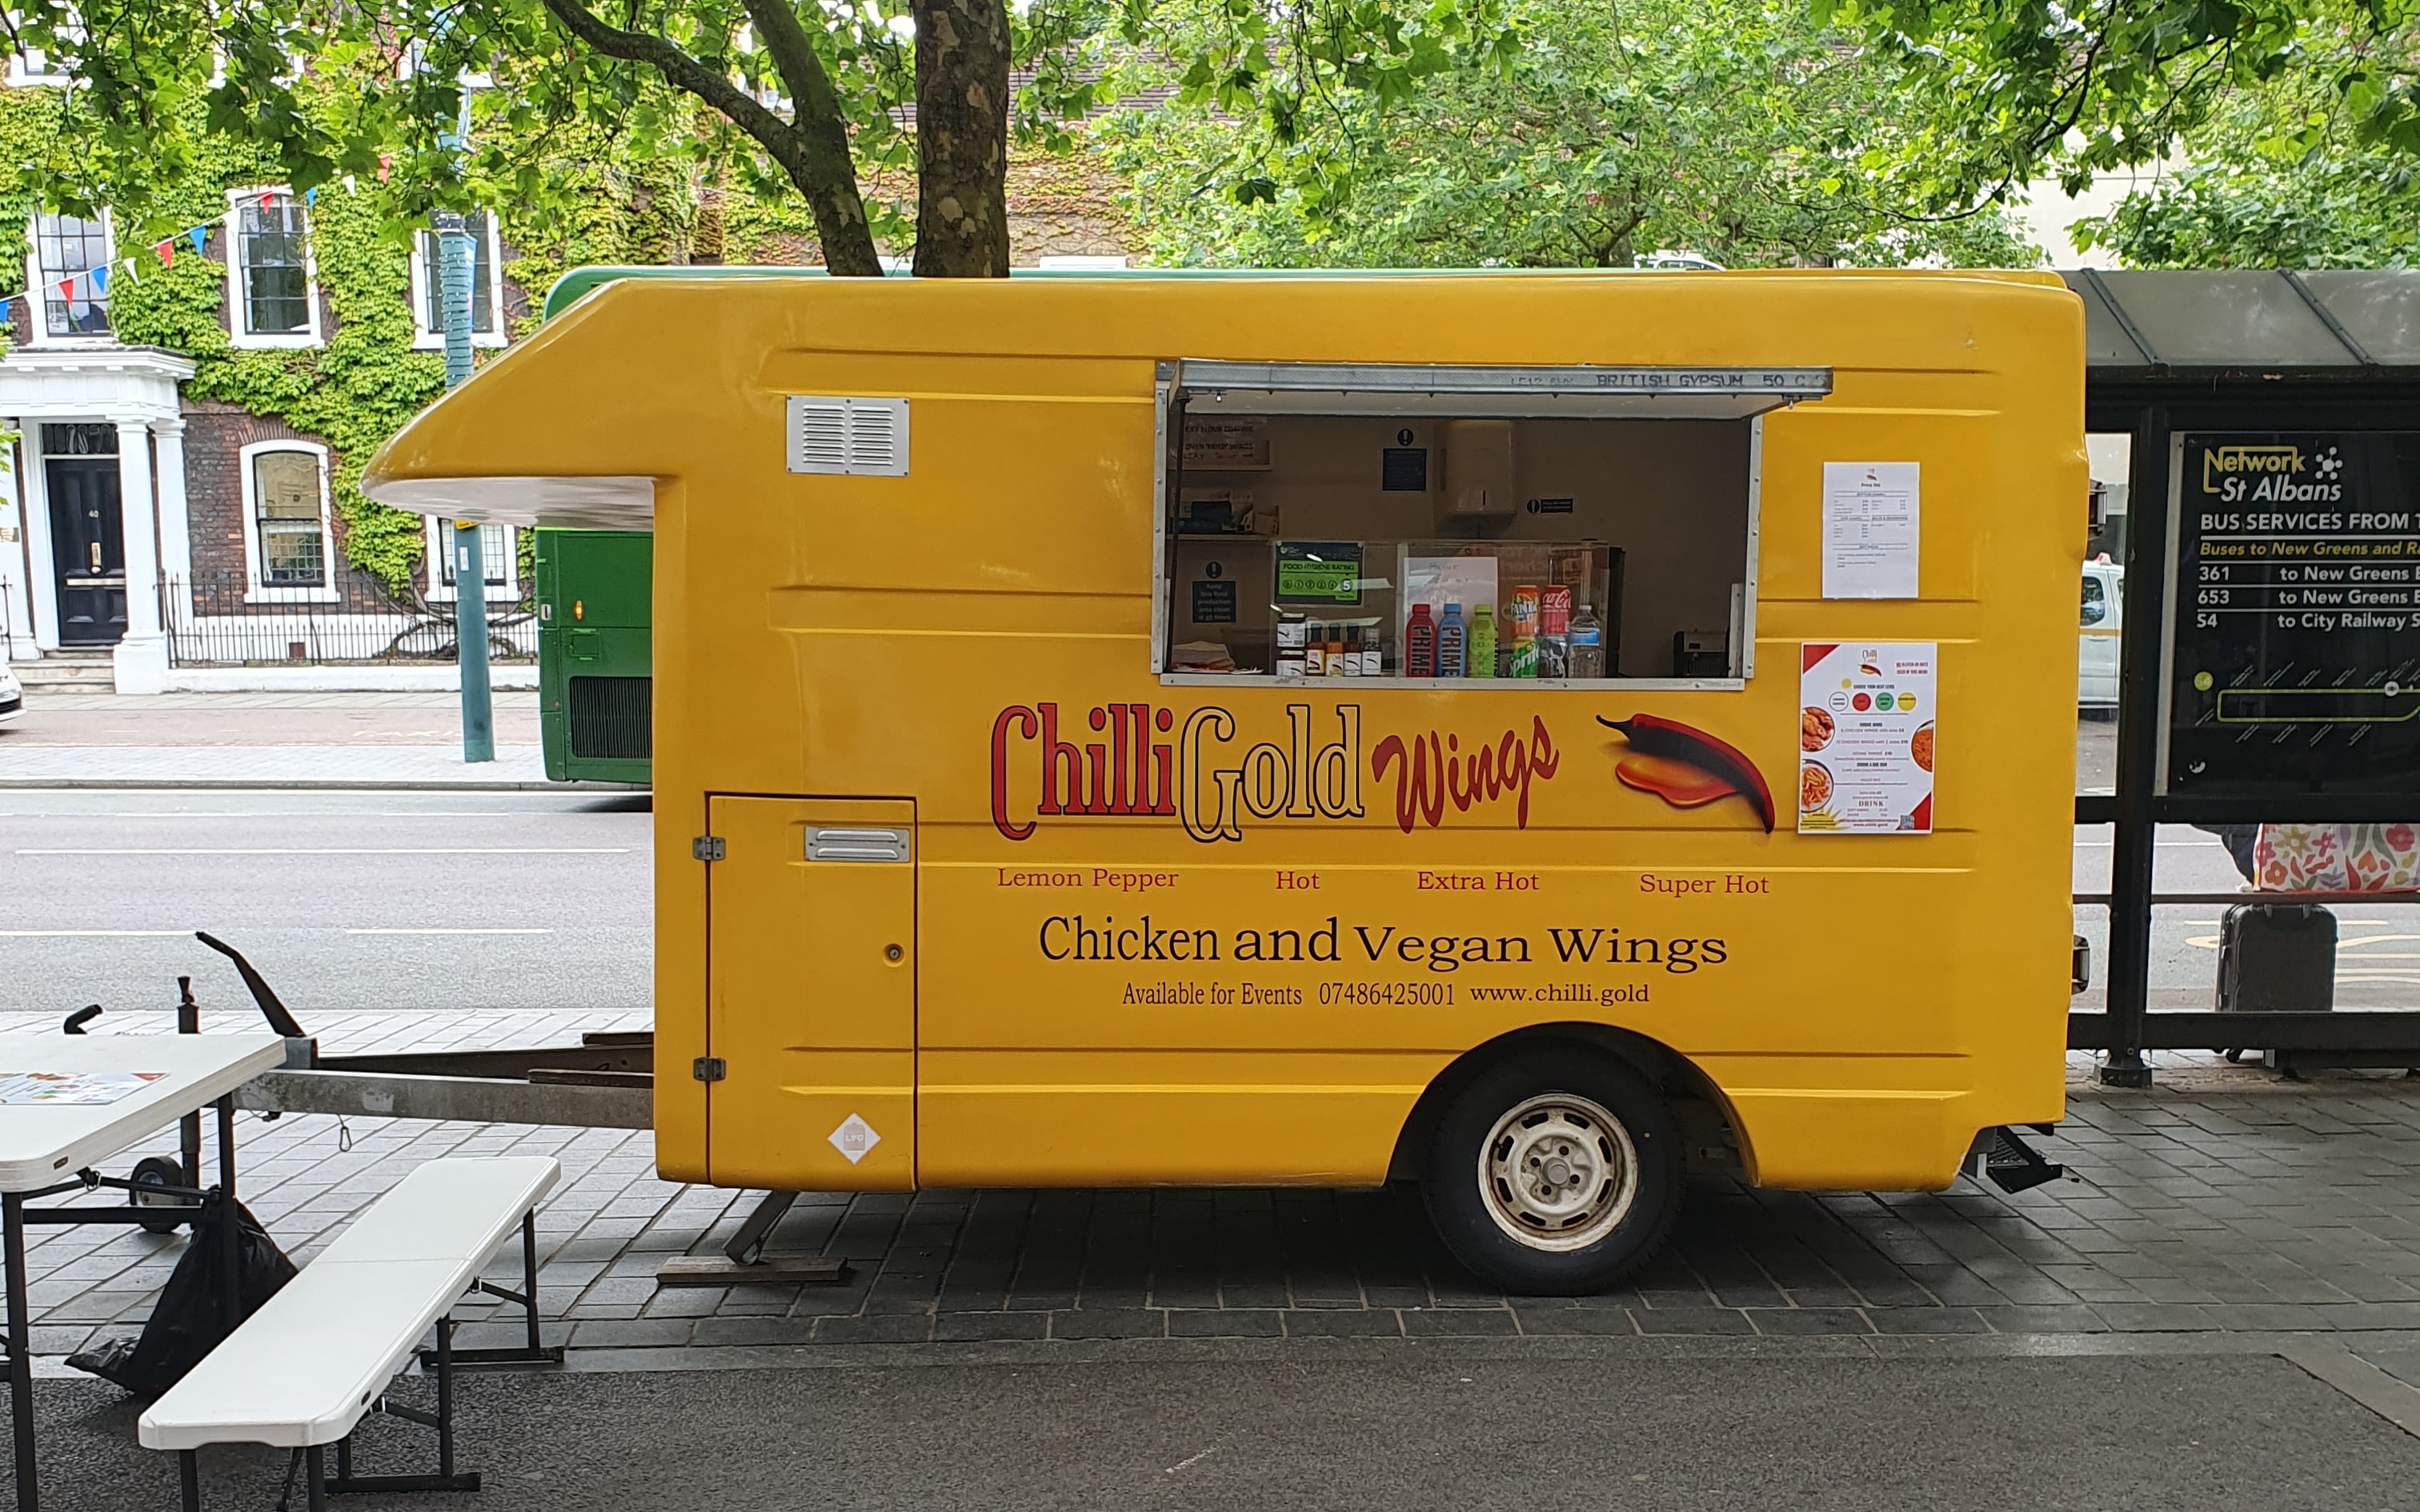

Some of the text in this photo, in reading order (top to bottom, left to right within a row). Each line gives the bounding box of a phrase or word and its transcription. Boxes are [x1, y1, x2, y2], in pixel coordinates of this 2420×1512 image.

[1597, 374, 1670, 387] BRITISH
[1680, 374, 1744, 387] GYPSUM
[2204, 446, 2306, 474] Network
[2221, 474, 2342, 502] St Albans
[2201, 514, 2240, 530] BUS
[2246, 514, 2342, 530] SERVICES
[2349, 513, 2409, 530] FROM
[2200, 542, 2245, 556] Buses
[2250, 542, 2267, 555] to
[2271, 542, 2308, 555] New
[2314, 542, 2369, 555] Greens
[2373, 541, 2402, 555] and
[2199, 566, 2230, 581] 361
[2280, 567, 2298, 581] to
[2304, 566, 2345, 581] New
[2349, 566, 2410, 581] Greens
[1342, 580, 1351, 590] 5
[2198, 590, 2230, 605] 653
[2278, 590, 2297, 604] to
[2303, 590, 2343, 604] New
[2348, 590, 2408, 604] Greens
[2197, 614, 2218, 628] S4
[2278, 615, 2296, 628] to
[2302, 613, 2336, 631] City
[2341, 612, 2406, 631] Railway
[1411, 625, 1432, 675] PRIME
[1441, 626, 1462, 677] PRIME
[1372, 715, 1561, 834] Wings
[997, 868, 1180, 893] Lemon Pepper
[1276, 870, 1320, 890] Hot
[1416, 871, 1540, 890] Extra Hot
[1640, 874, 1769, 898] Super Hot
[1040, 914, 1727, 974] Chicken and Vegan Wings
[1122, 981, 1650, 1007] Available for Events 07486425001 www.chilli.gold
